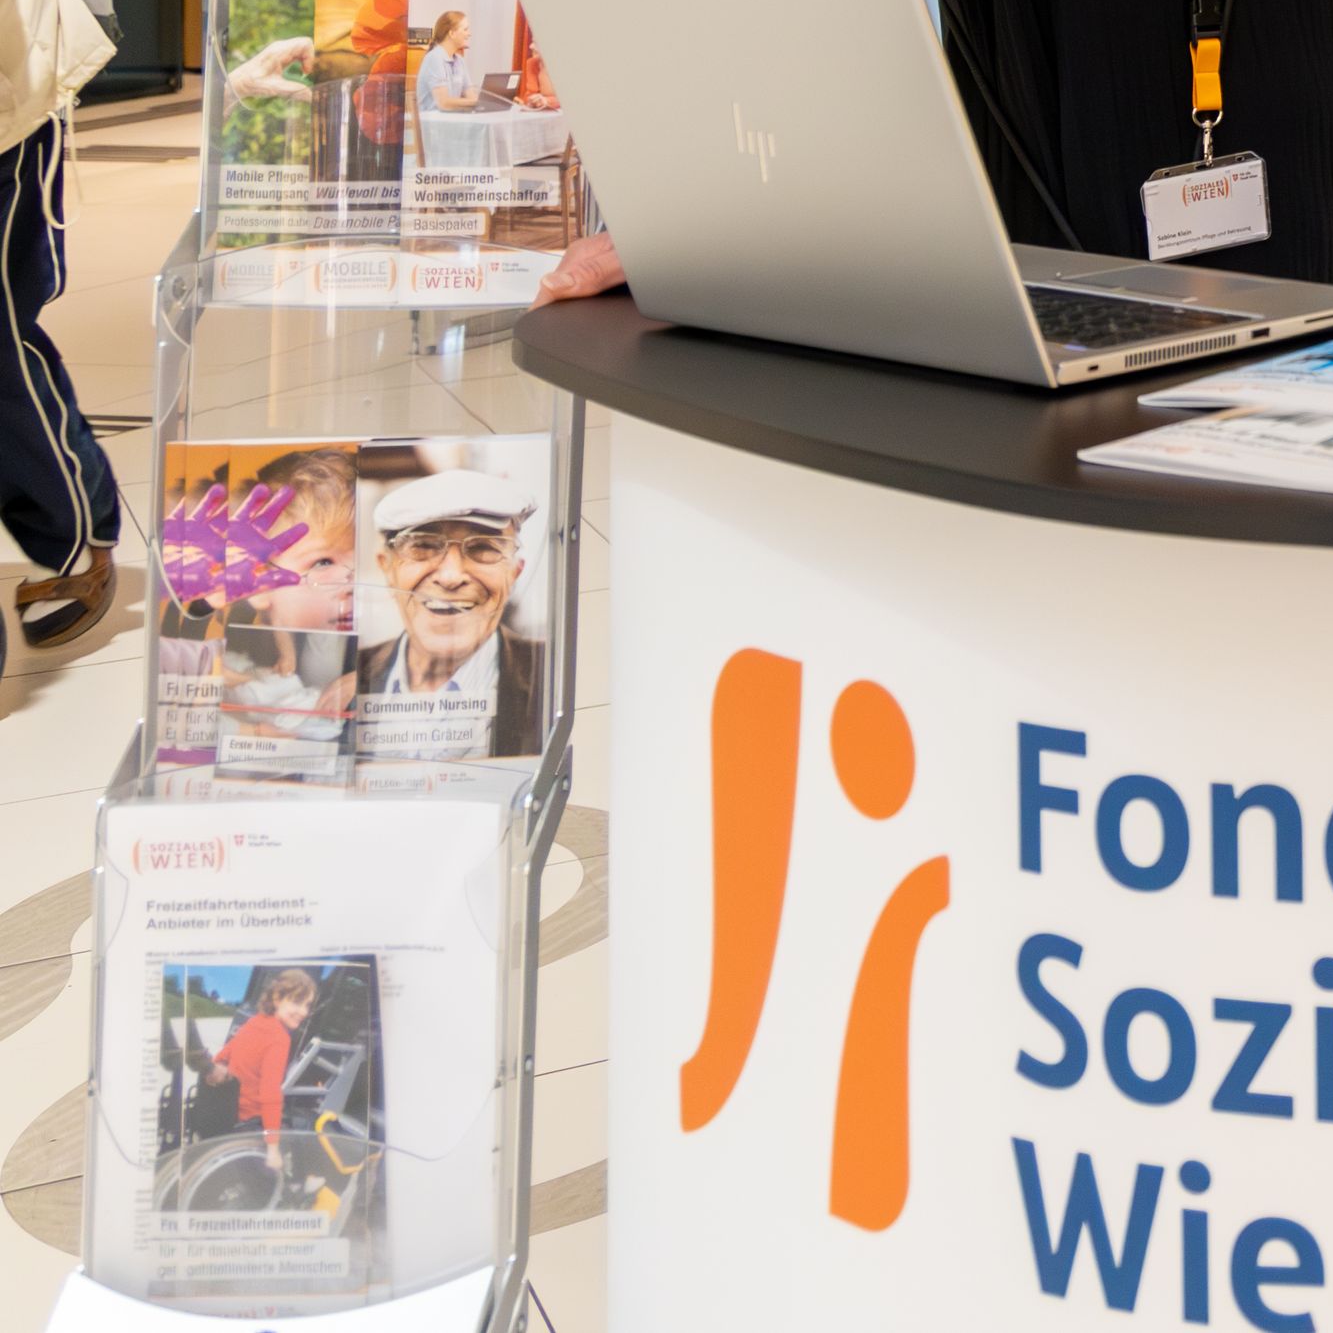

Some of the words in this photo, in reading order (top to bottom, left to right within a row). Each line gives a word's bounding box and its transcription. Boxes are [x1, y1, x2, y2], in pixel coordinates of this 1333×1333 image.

[226, 170, 264, 182] Mobile
[383, 186, 400, 198] bis
[1190, 180, 1224, 192] SOZIALES
[414, 189, 549, 204] Wohngemeinschaften
[1191, 188, 1226, 202] WIEN
[313, 217, 338, 229] Das
[341, 216, 382, 229] mobile
[413, 218, 478, 232] Basispaket
[323, 261, 387, 276] MOBILE
[425, 276, 476, 289] WIEN
[364, 700, 435, 715] Community
[439, 697, 488, 713] Nursing
[363, 730, 409, 744] Gesund
[412, 729, 428, 742] im
[431, 728, 473, 742] Grätzel
[229, 739, 254, 751] Erste
[149, 841, 216, 853] SOZIALES
[149, 853, 216, 869] WIEN
[146, 897, 305, 914] Freizeitfahrtendienst
[146, 917, 211, 931] Anbieter
[216, 916, 235, 928] im
[240, 913, 313, 927] Überblick
